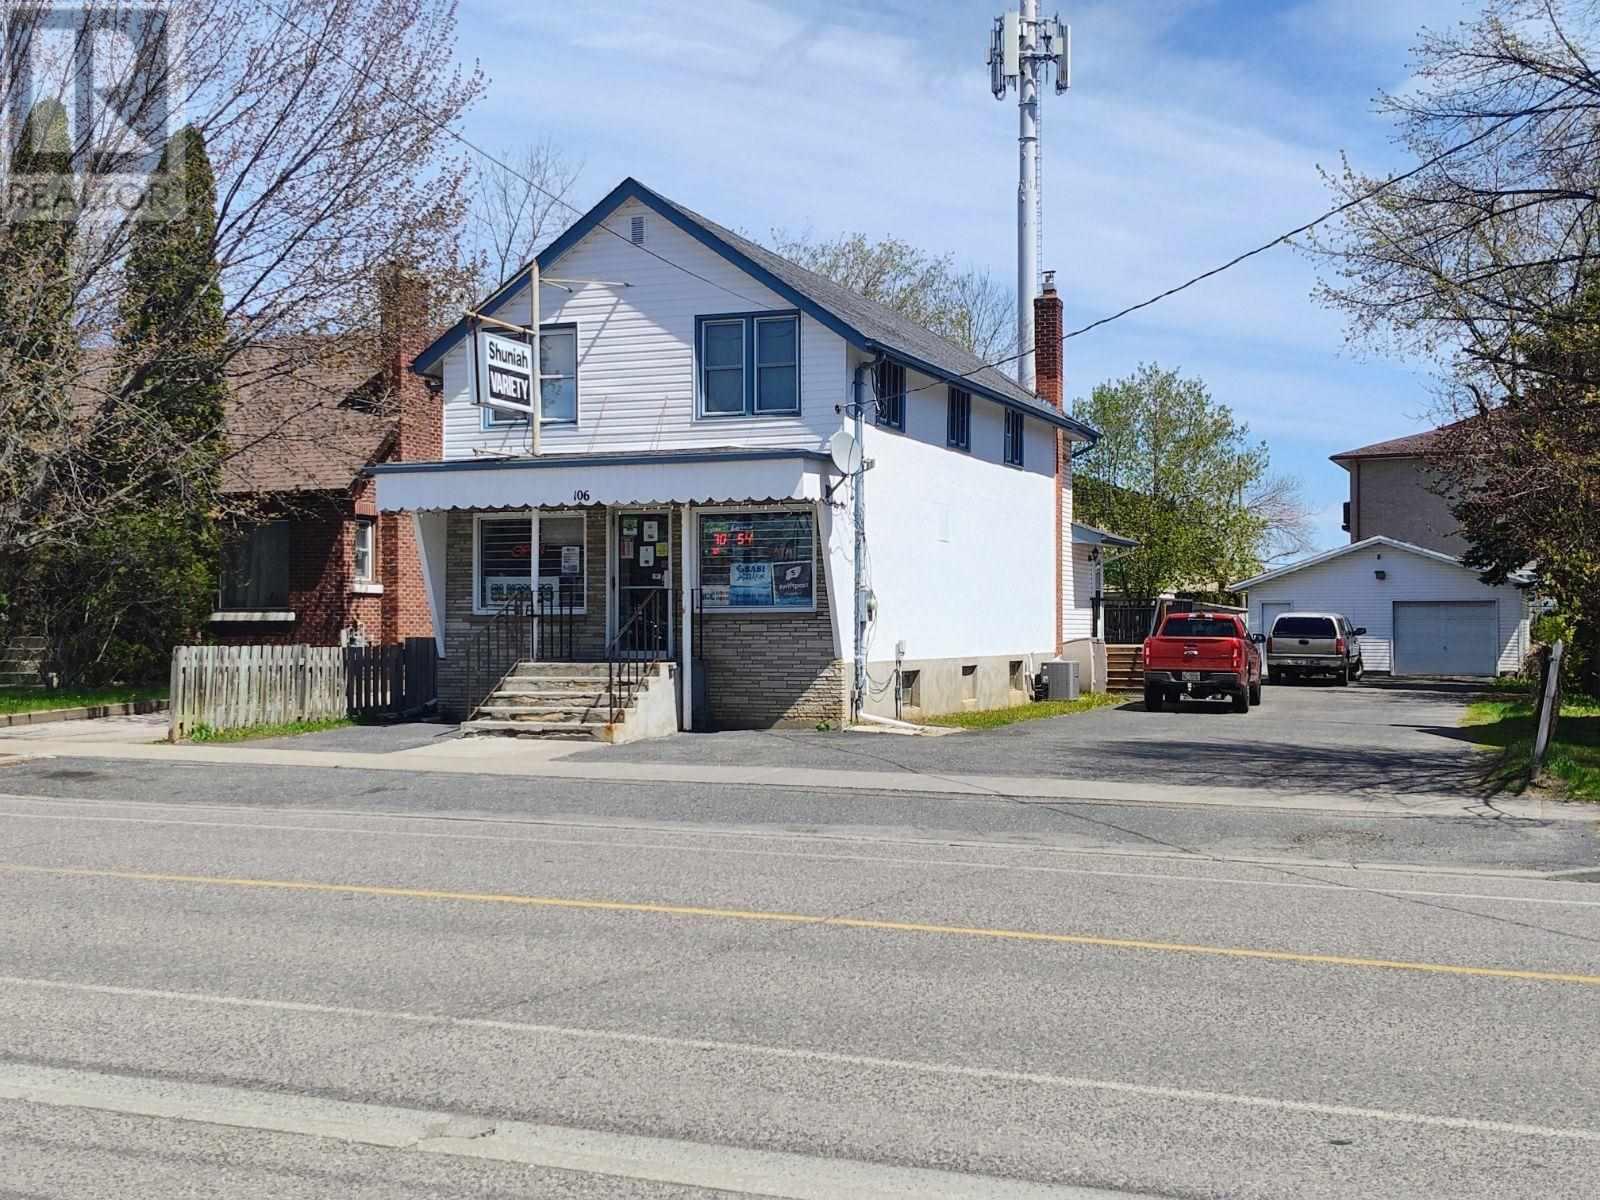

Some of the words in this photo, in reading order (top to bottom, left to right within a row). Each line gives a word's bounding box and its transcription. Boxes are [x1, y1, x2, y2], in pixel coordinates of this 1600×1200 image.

[489, 341, 528, 368] Shuniah
[490, 370, 529, 400] VARIETY
[574, 489, 590, 501] 106
